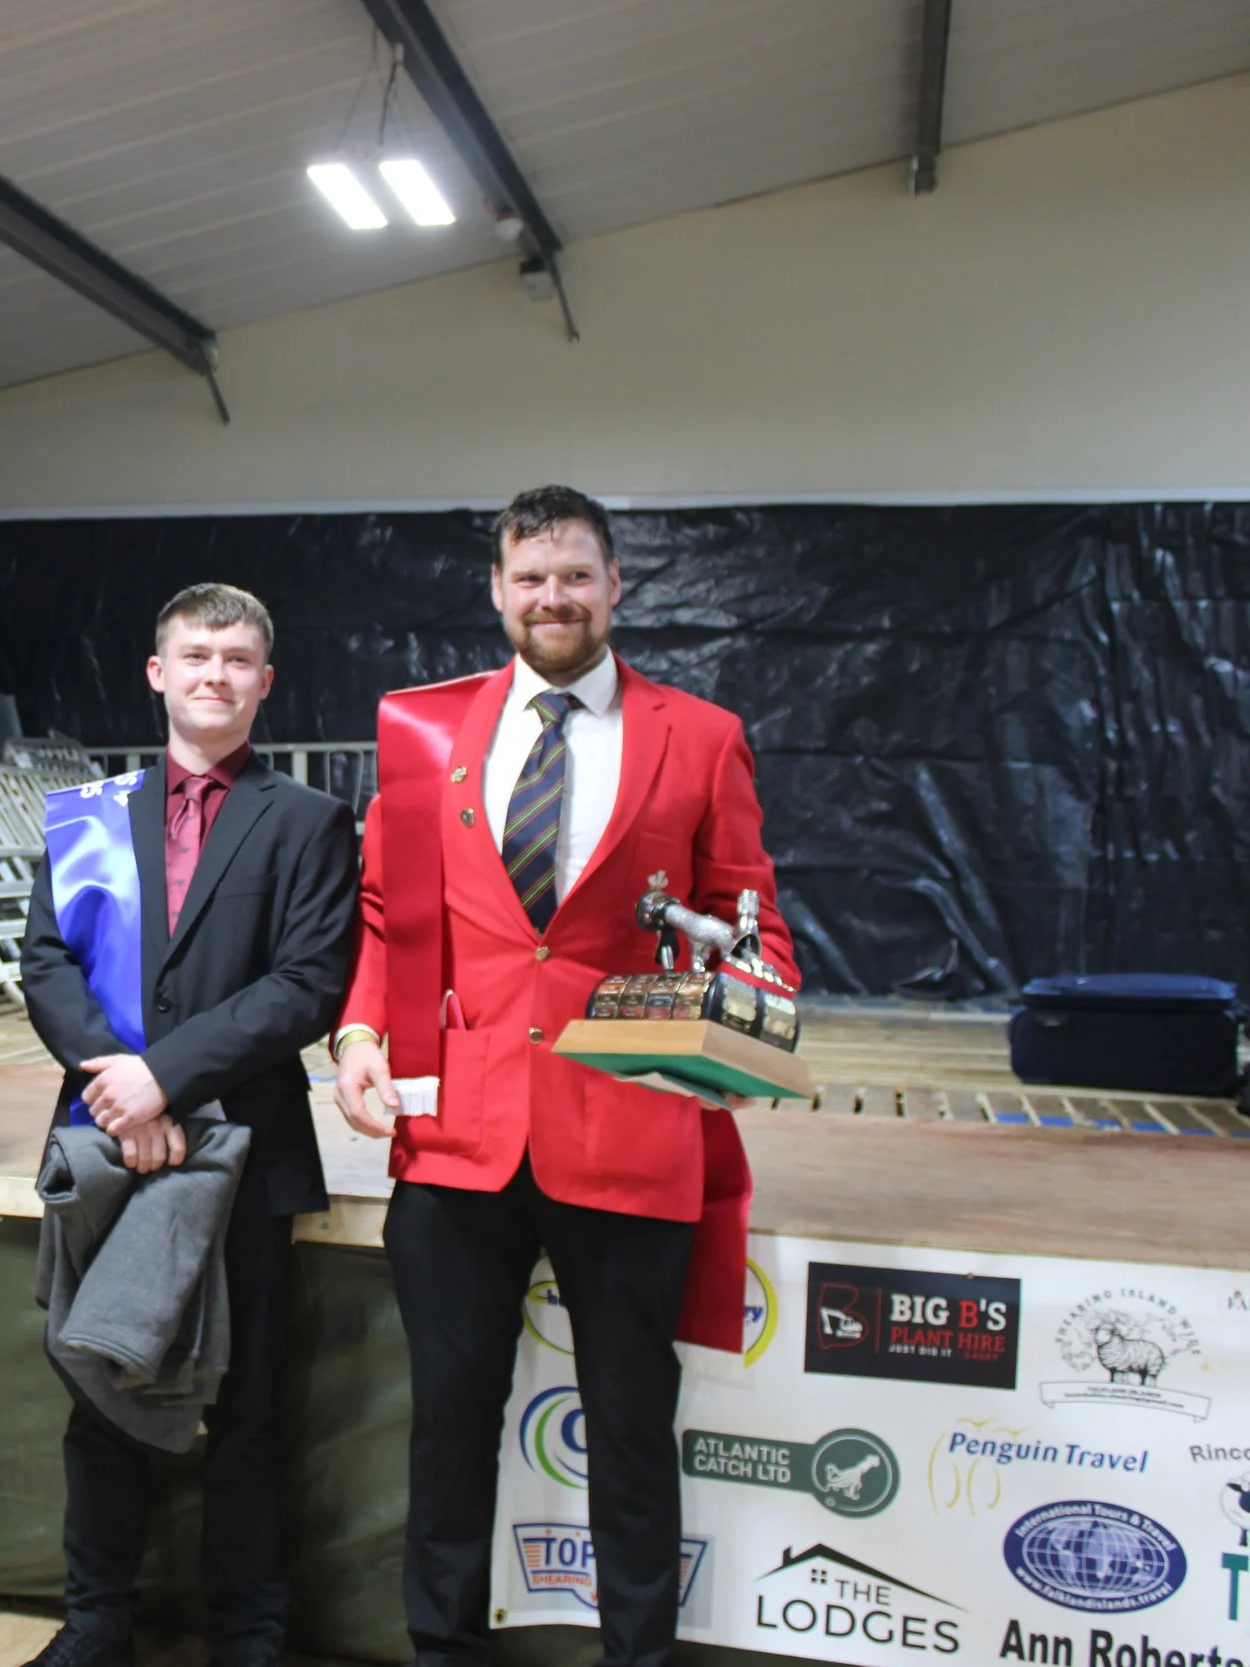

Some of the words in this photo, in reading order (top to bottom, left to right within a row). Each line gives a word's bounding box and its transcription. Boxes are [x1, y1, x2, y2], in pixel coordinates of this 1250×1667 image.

[890, 1293, 950, 1326] BIG
[958, 1298, 1007, 1331] B'S
[1054, 1289, 1113, 1344] SHEARING
[1120, 1288, 1177, 1315] ISLAND
[888, 1343, 916, 1354] JUST
[940, 1349, 953, 1358] IT
[890, 1326, 953, 1348] PLANT
[957, 1333, 1006, 1353] HIRE
[693, 1456, 753, 1478] CATCH
[756, 1465, 792, 1484] LTD
[694, 1437, 791, 1466] ATLANTIC
[949, 1432, 1059, 1465] Penguin
[1065, 1444, 1150, 1473] Travel
[1014, 1502, 1092, 1538] International
[1094, 1503, 1129, 1522] Tours
[1141, 1518, 1178, 1551] Travel
[835, 1579, 892, 1606] THE
[756, 1594, 960, 1654] LODGES
[999, 1619, 1073, 1666] Ann
